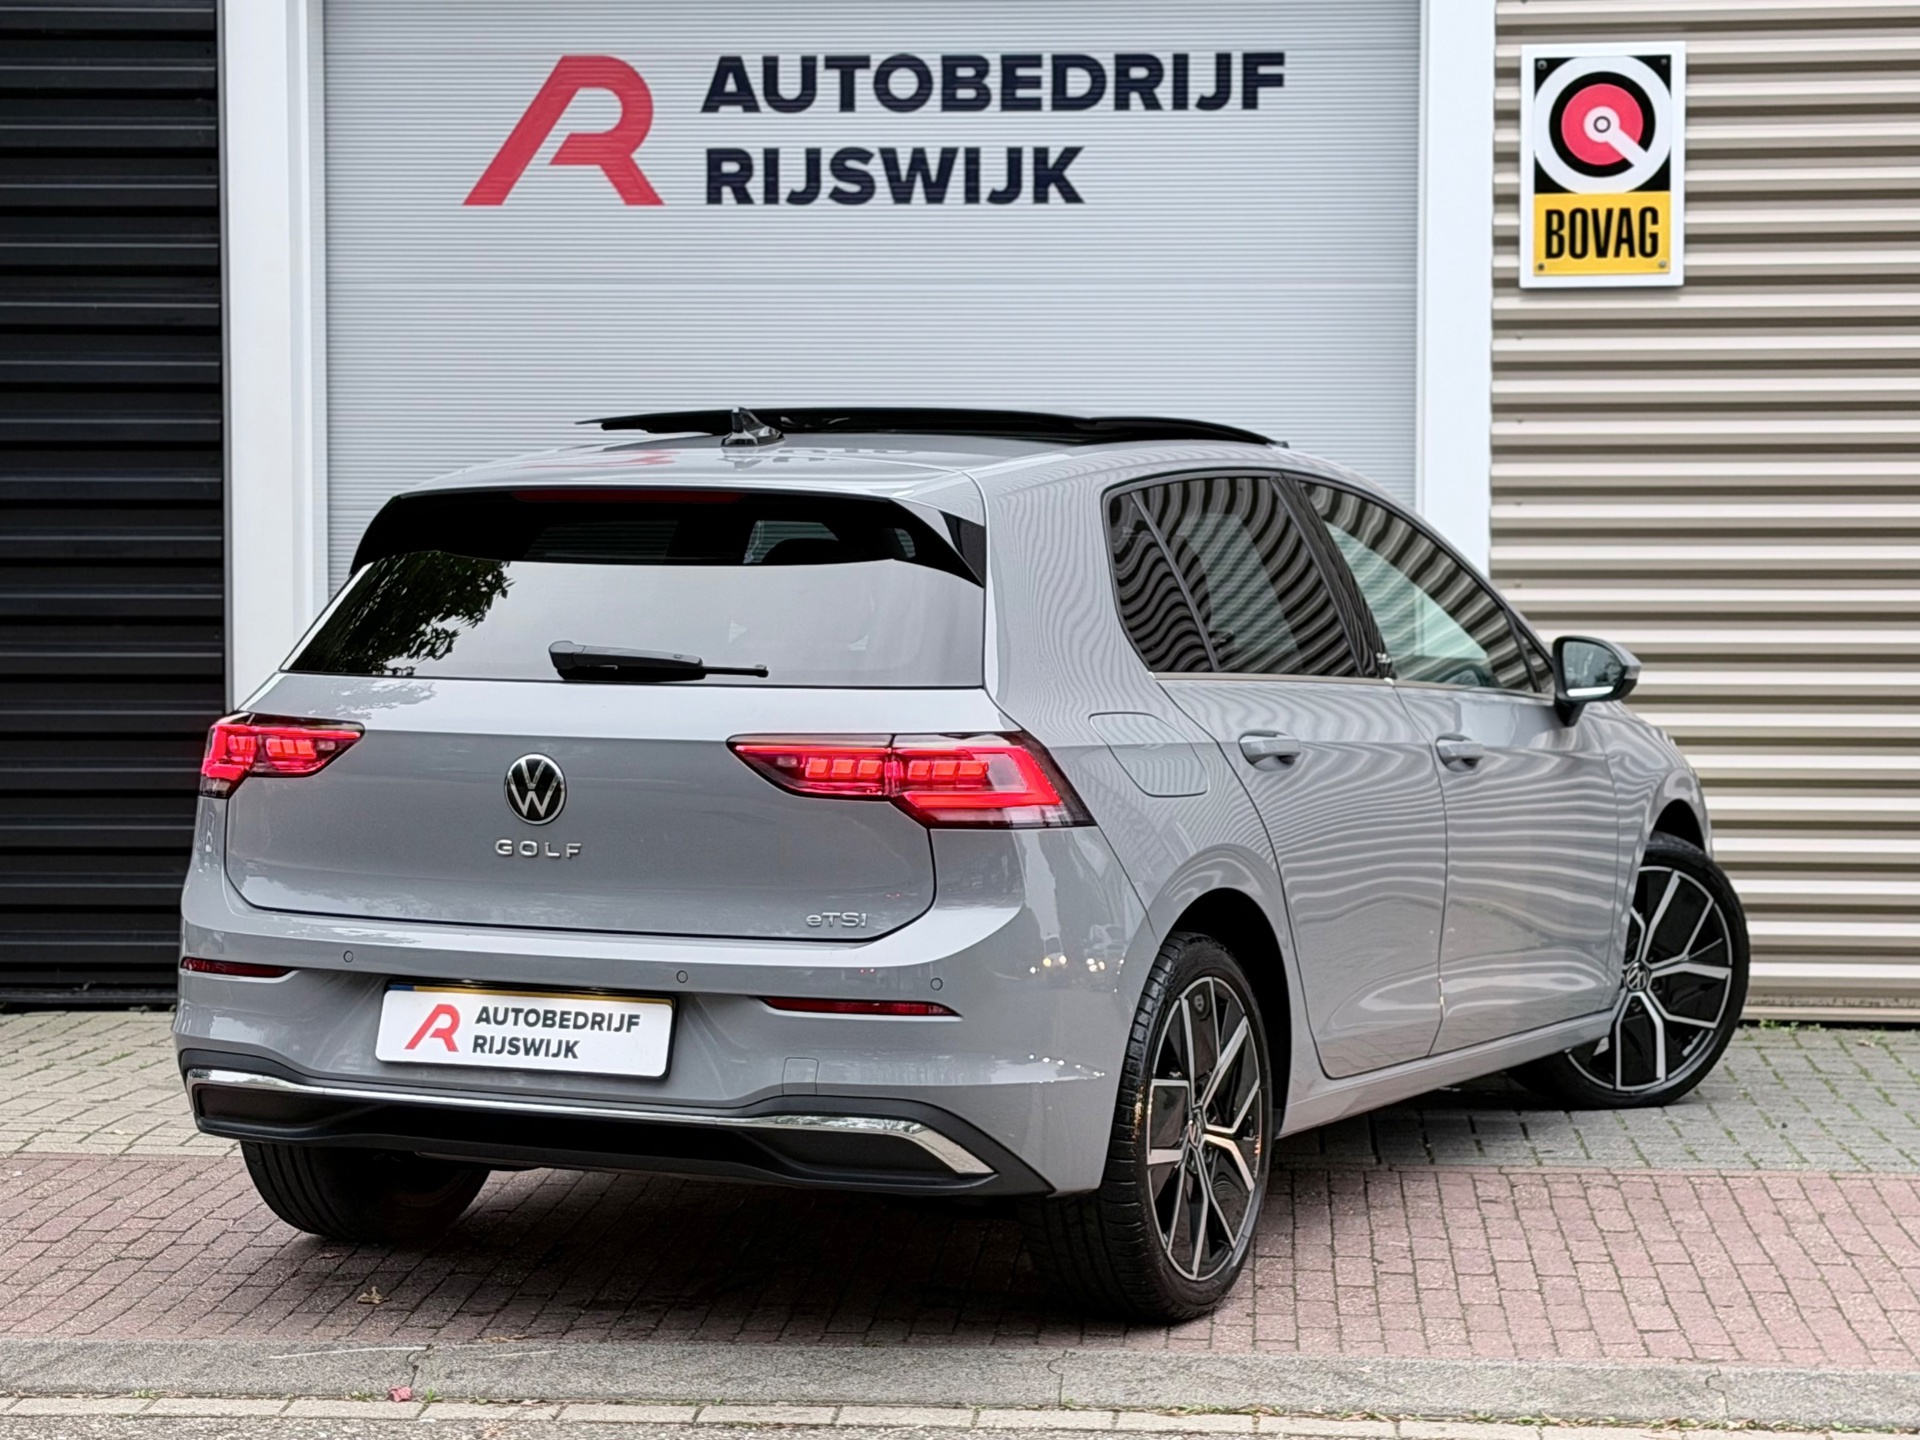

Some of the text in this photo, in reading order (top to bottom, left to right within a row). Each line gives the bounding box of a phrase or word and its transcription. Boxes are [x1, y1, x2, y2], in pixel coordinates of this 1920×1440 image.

[701, 52, 1285, 113] AUTOBEDRIJF
[706, 147, 1085, 206] RIJSWIJK
[1545, 206, 1659, 259] BOVAG
[494, 839, 583, 859] GOLF
[805, 911, 868, 928] eTSI
[475, 1006, 641, 1032] AUTOBEDRIJF
[472, 1034, 580, 1059] RIJSWIJK
